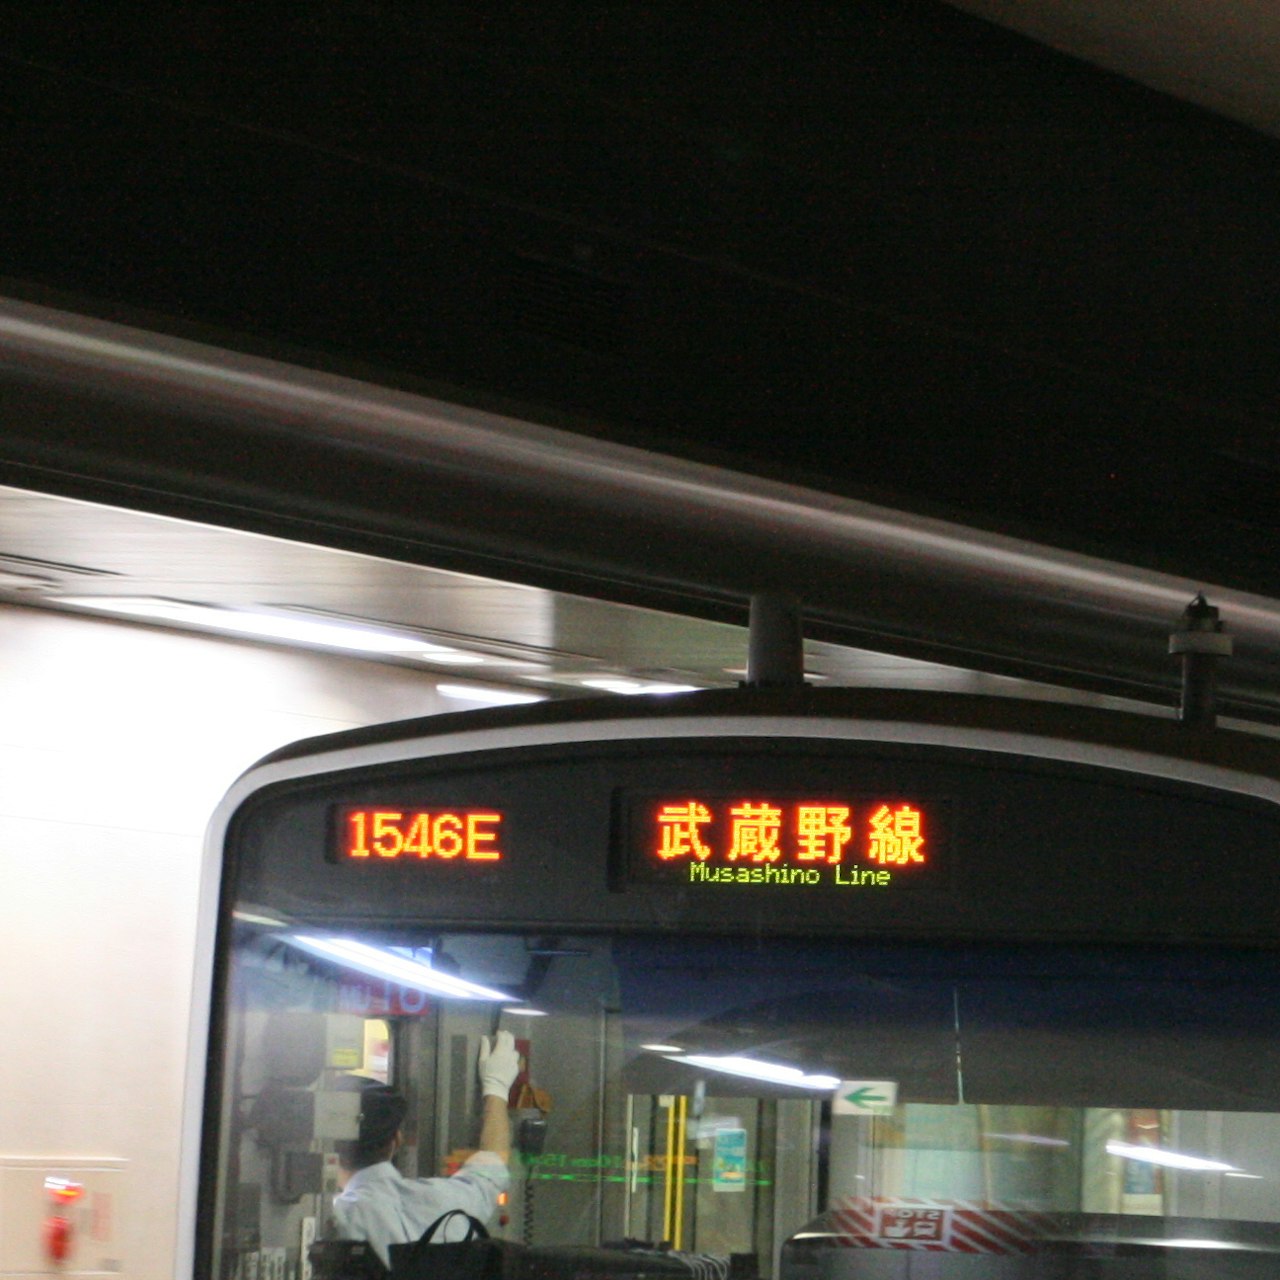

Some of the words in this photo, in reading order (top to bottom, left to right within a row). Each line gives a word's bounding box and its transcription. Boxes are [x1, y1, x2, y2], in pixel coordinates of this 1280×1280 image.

[350, 812, 501, 860] 1546E
[657, 801, 926, 864] 武蔵野線
[690, 860, 821, 886] Musashino
[834, 864, 891, 886] Line
